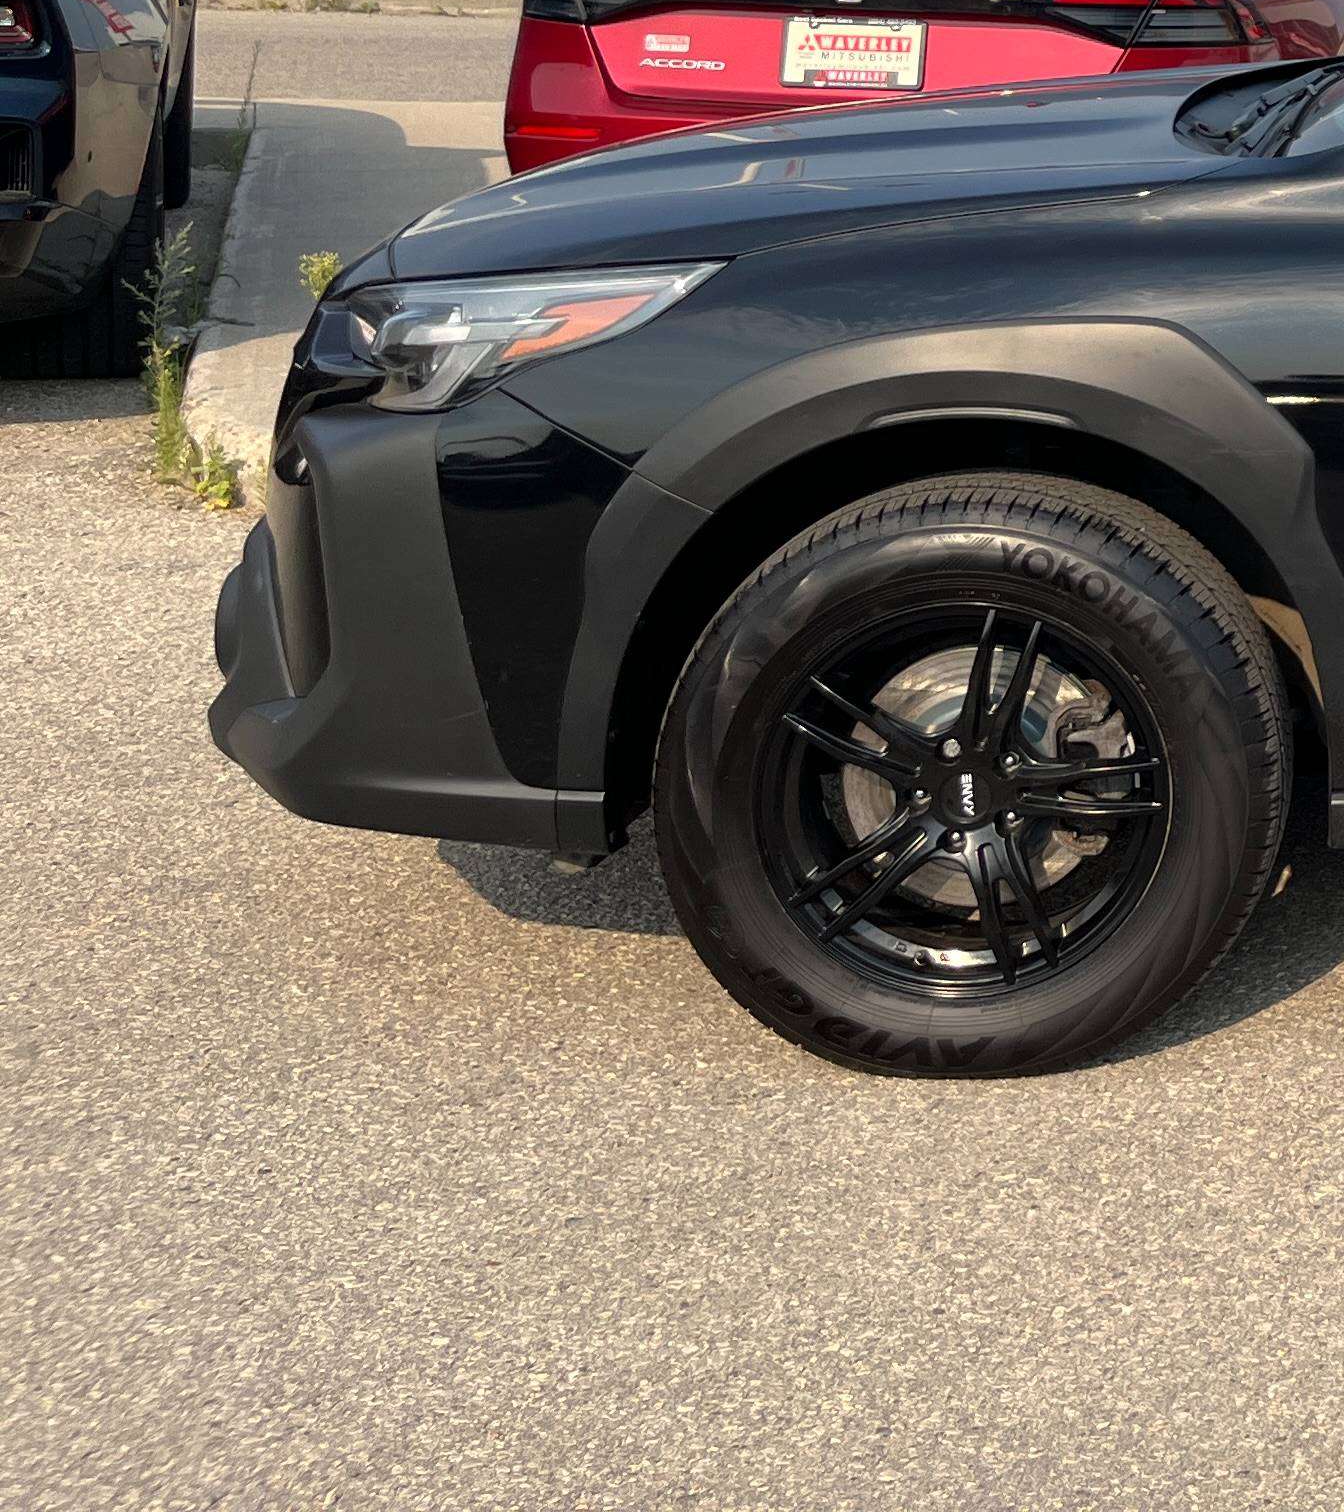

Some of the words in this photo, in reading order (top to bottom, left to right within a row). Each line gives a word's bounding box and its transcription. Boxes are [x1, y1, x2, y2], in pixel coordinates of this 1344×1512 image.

[820, 36, 911, 52] WAVERLEY
[640, 57, 726, 71] ACCORD
[821, 52, 910, 63] MITSUBISHI
[1000, 540, 1207, 700] YOKOHAMA
[961, 773, 975, 817] ENVY
